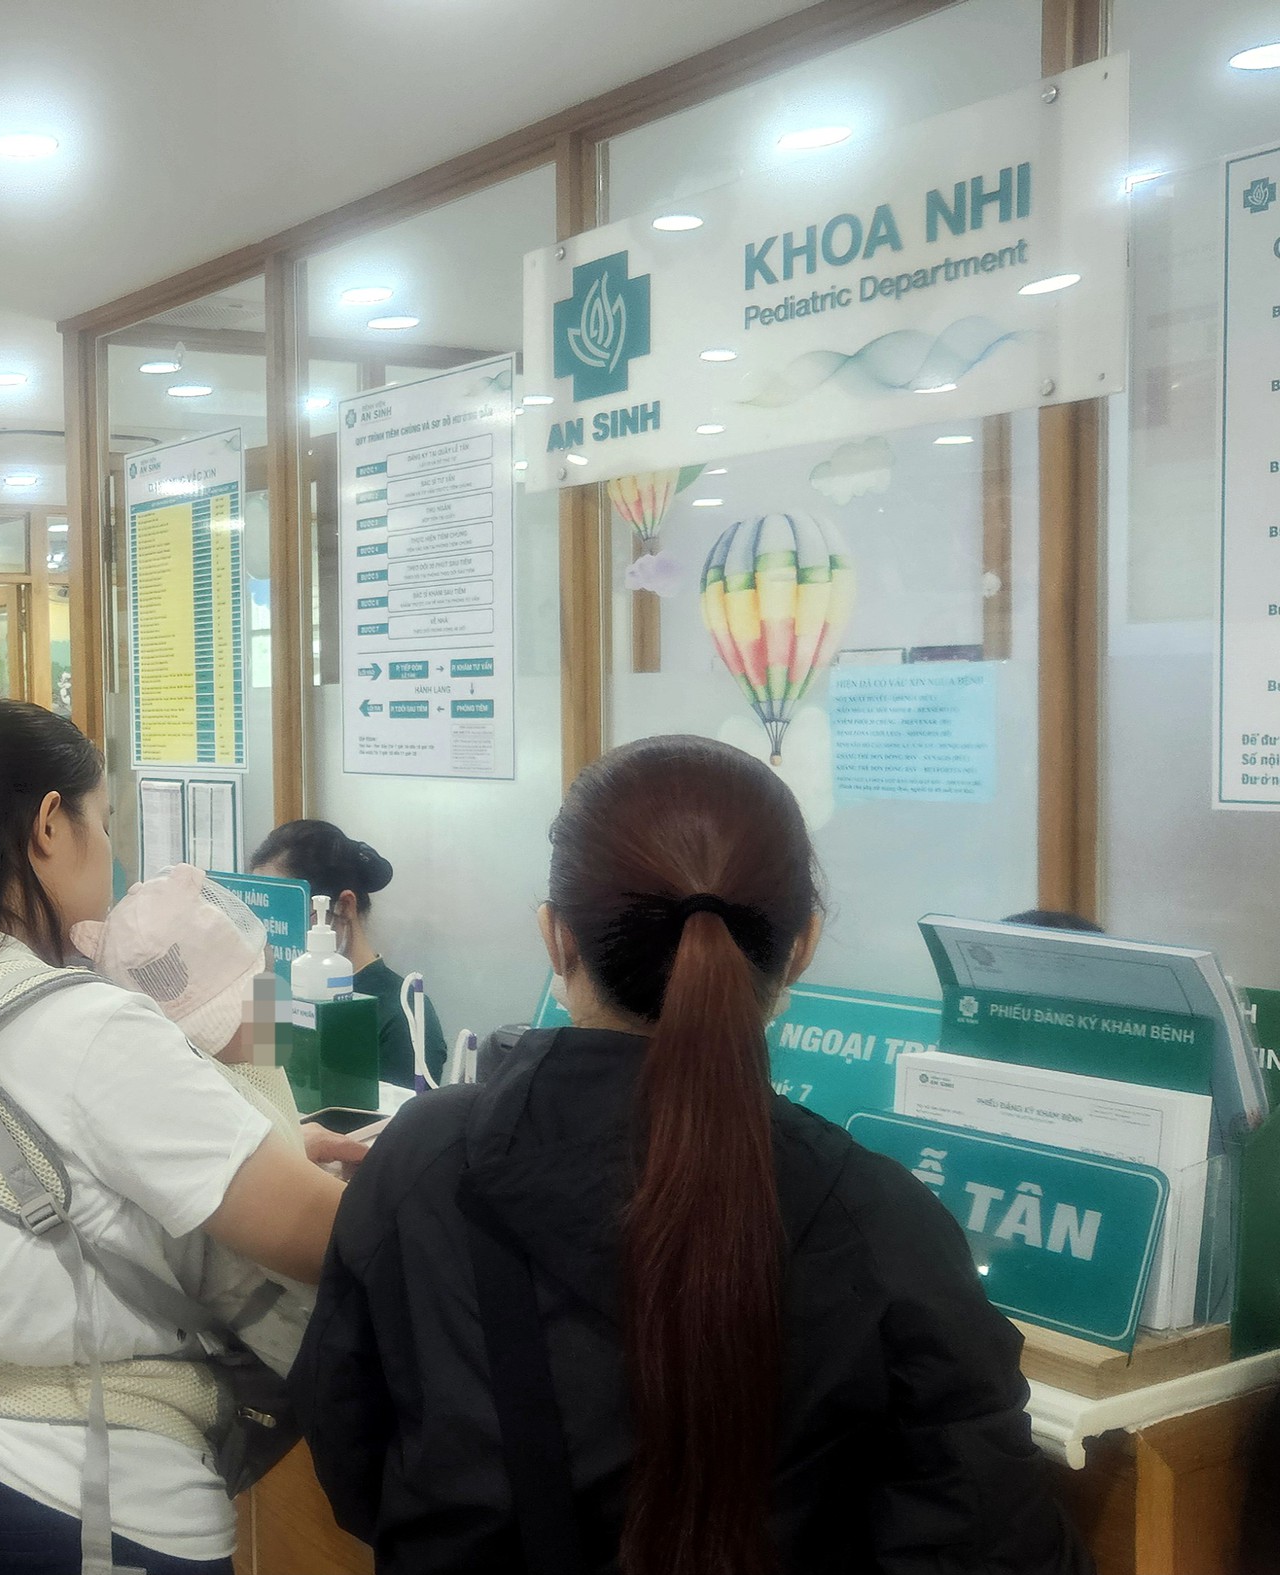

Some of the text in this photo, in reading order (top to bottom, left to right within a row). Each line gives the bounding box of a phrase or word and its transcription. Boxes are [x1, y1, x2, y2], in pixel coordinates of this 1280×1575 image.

[744, 161, 1030, 291] KHOA NHI
[744, 238, 1028, 330] Pediatric Department
[361, 407, 392, 423] AN SINH
[546, 400, 660, 453] AN SINH
[433, 685, 451, 694] LANG
[1241, 752, 1258, 765] Số
[245, 889, 270, 907] HÀNG
[779, 1022, 877, 1065] NGOẠI
[989, 1002, 1195, 1045] PHIẾU ĐĂNG KÝ KHÁM BỆNH
[799, 1083, 814, 1103] 7
[965, 1181, 1103, 1262] TÂN
